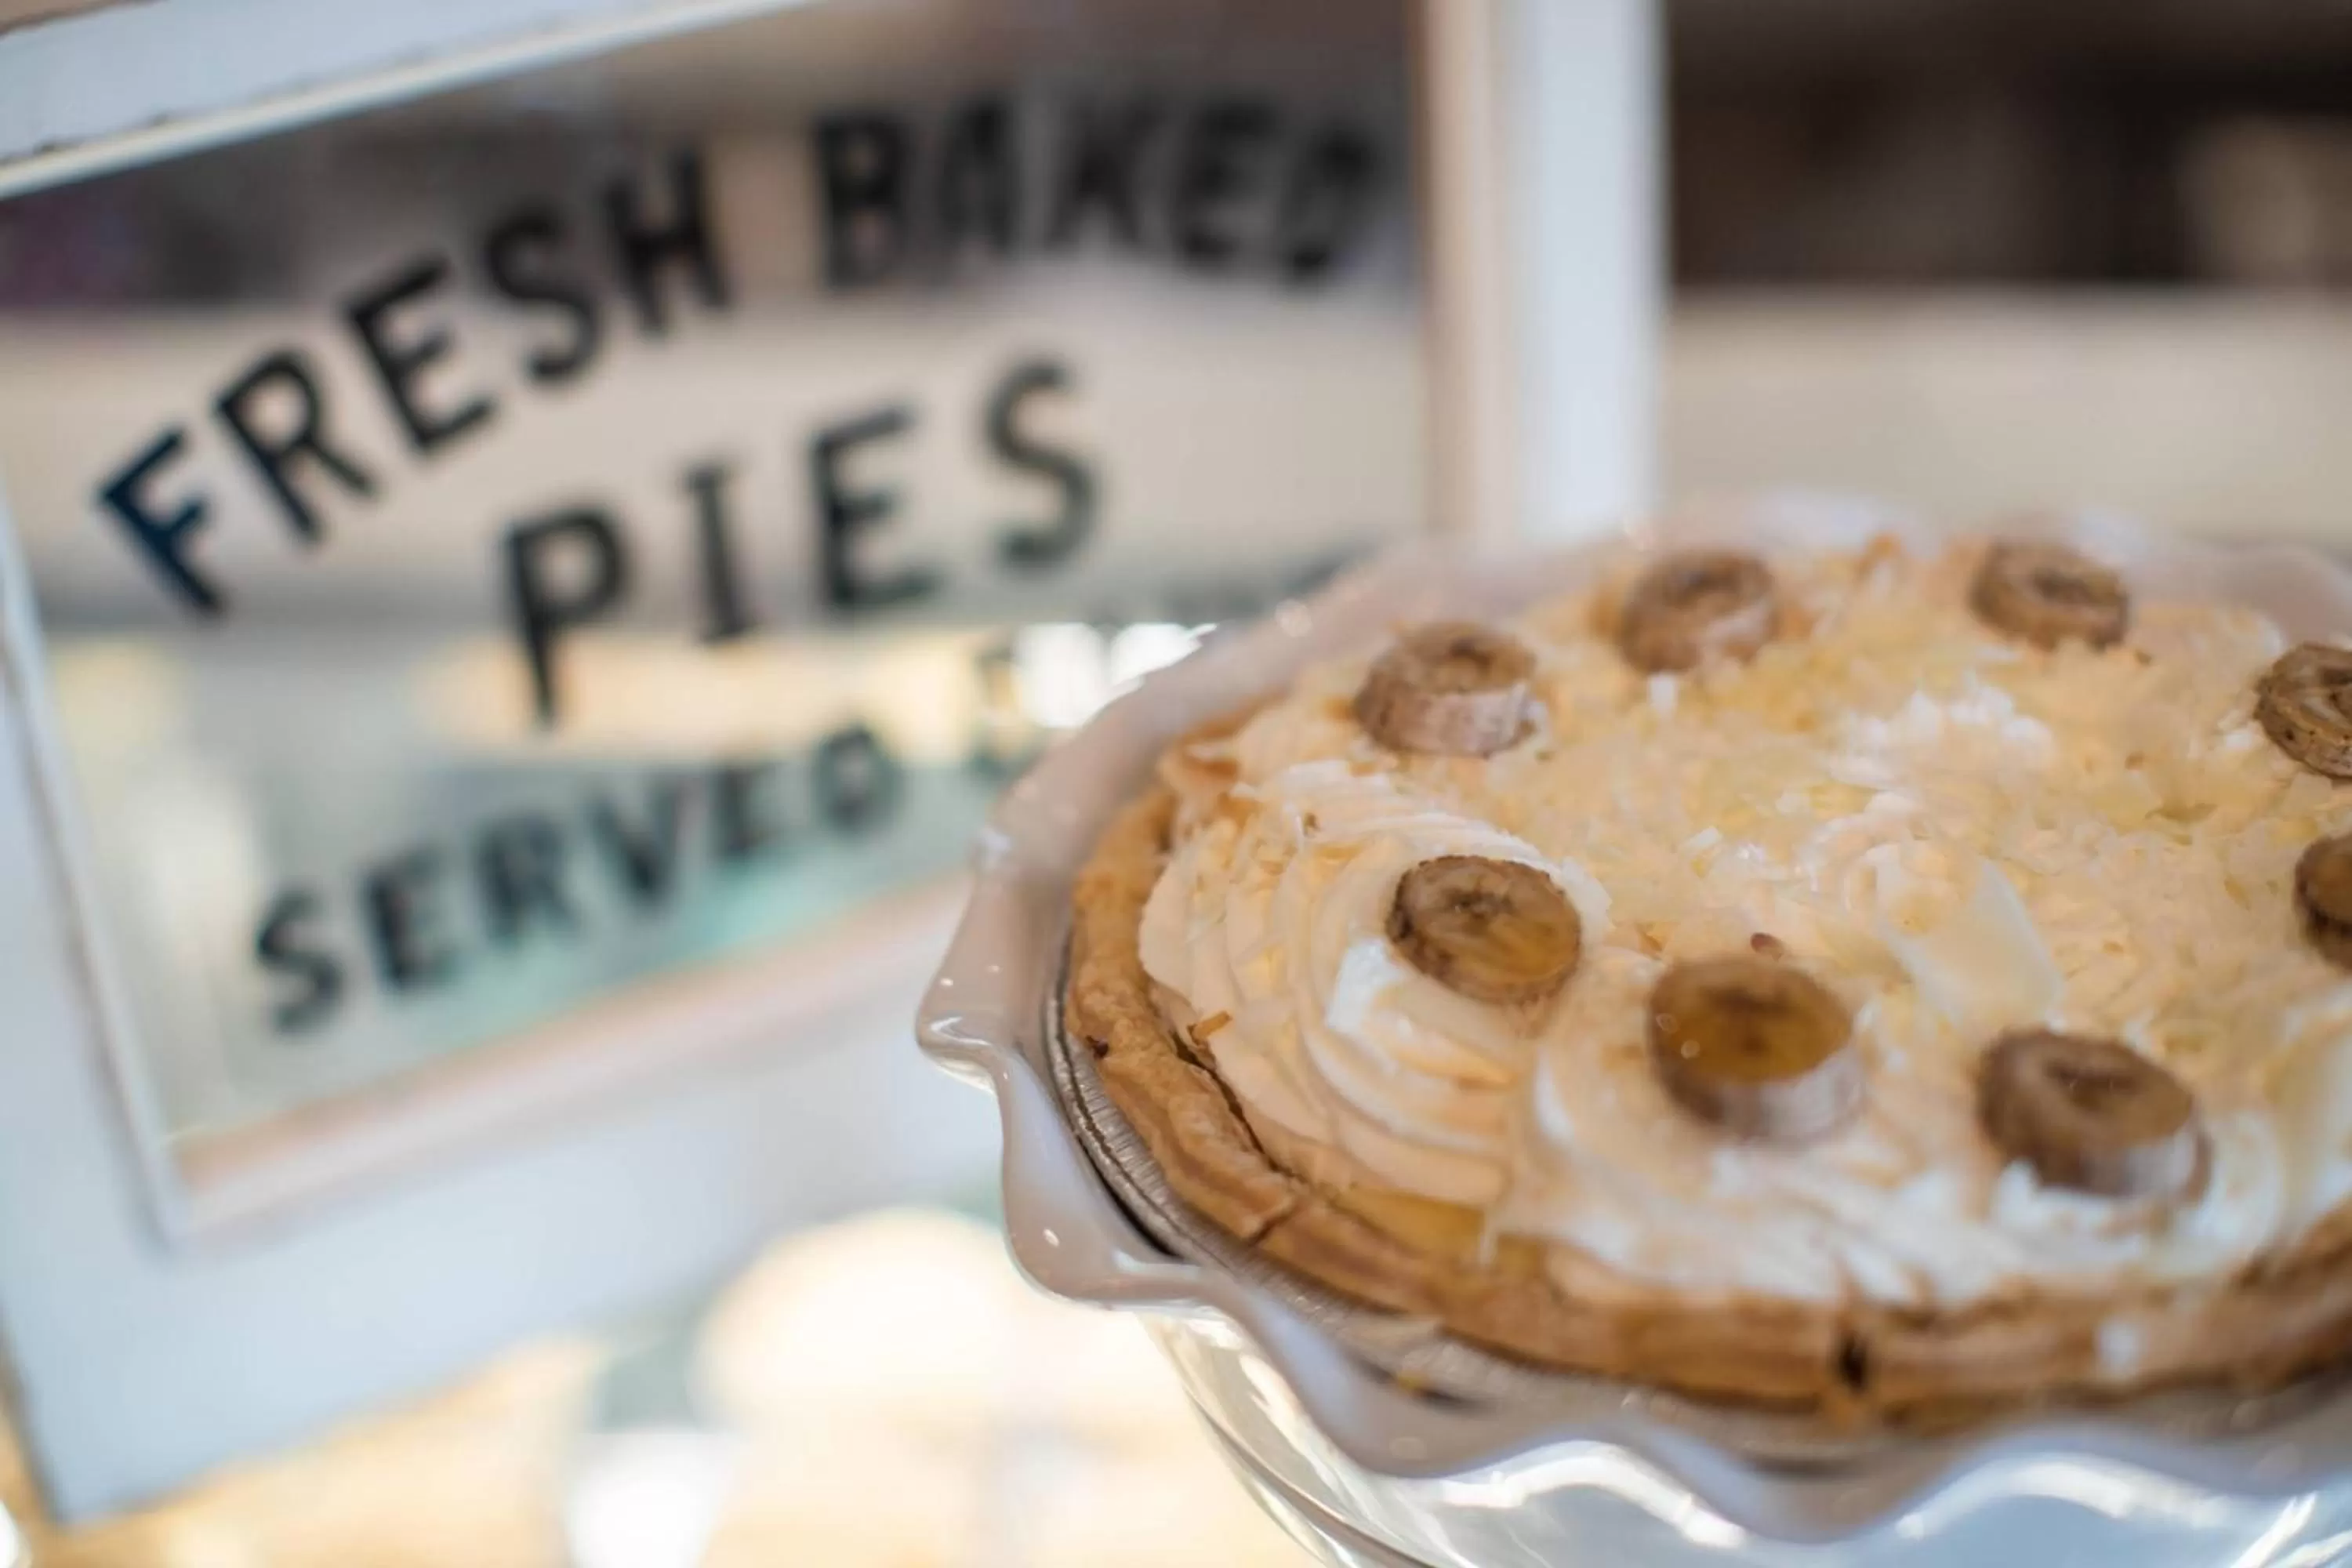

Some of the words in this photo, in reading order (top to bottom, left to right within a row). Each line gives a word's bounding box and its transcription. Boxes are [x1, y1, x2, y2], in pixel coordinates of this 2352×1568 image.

[96, 144, 735, 618] FRESH
[814, 93, 1383, 289] BAKED
[500, 357, 1104, 726] PIES
[252, 720, 903, 1035] SERVED
